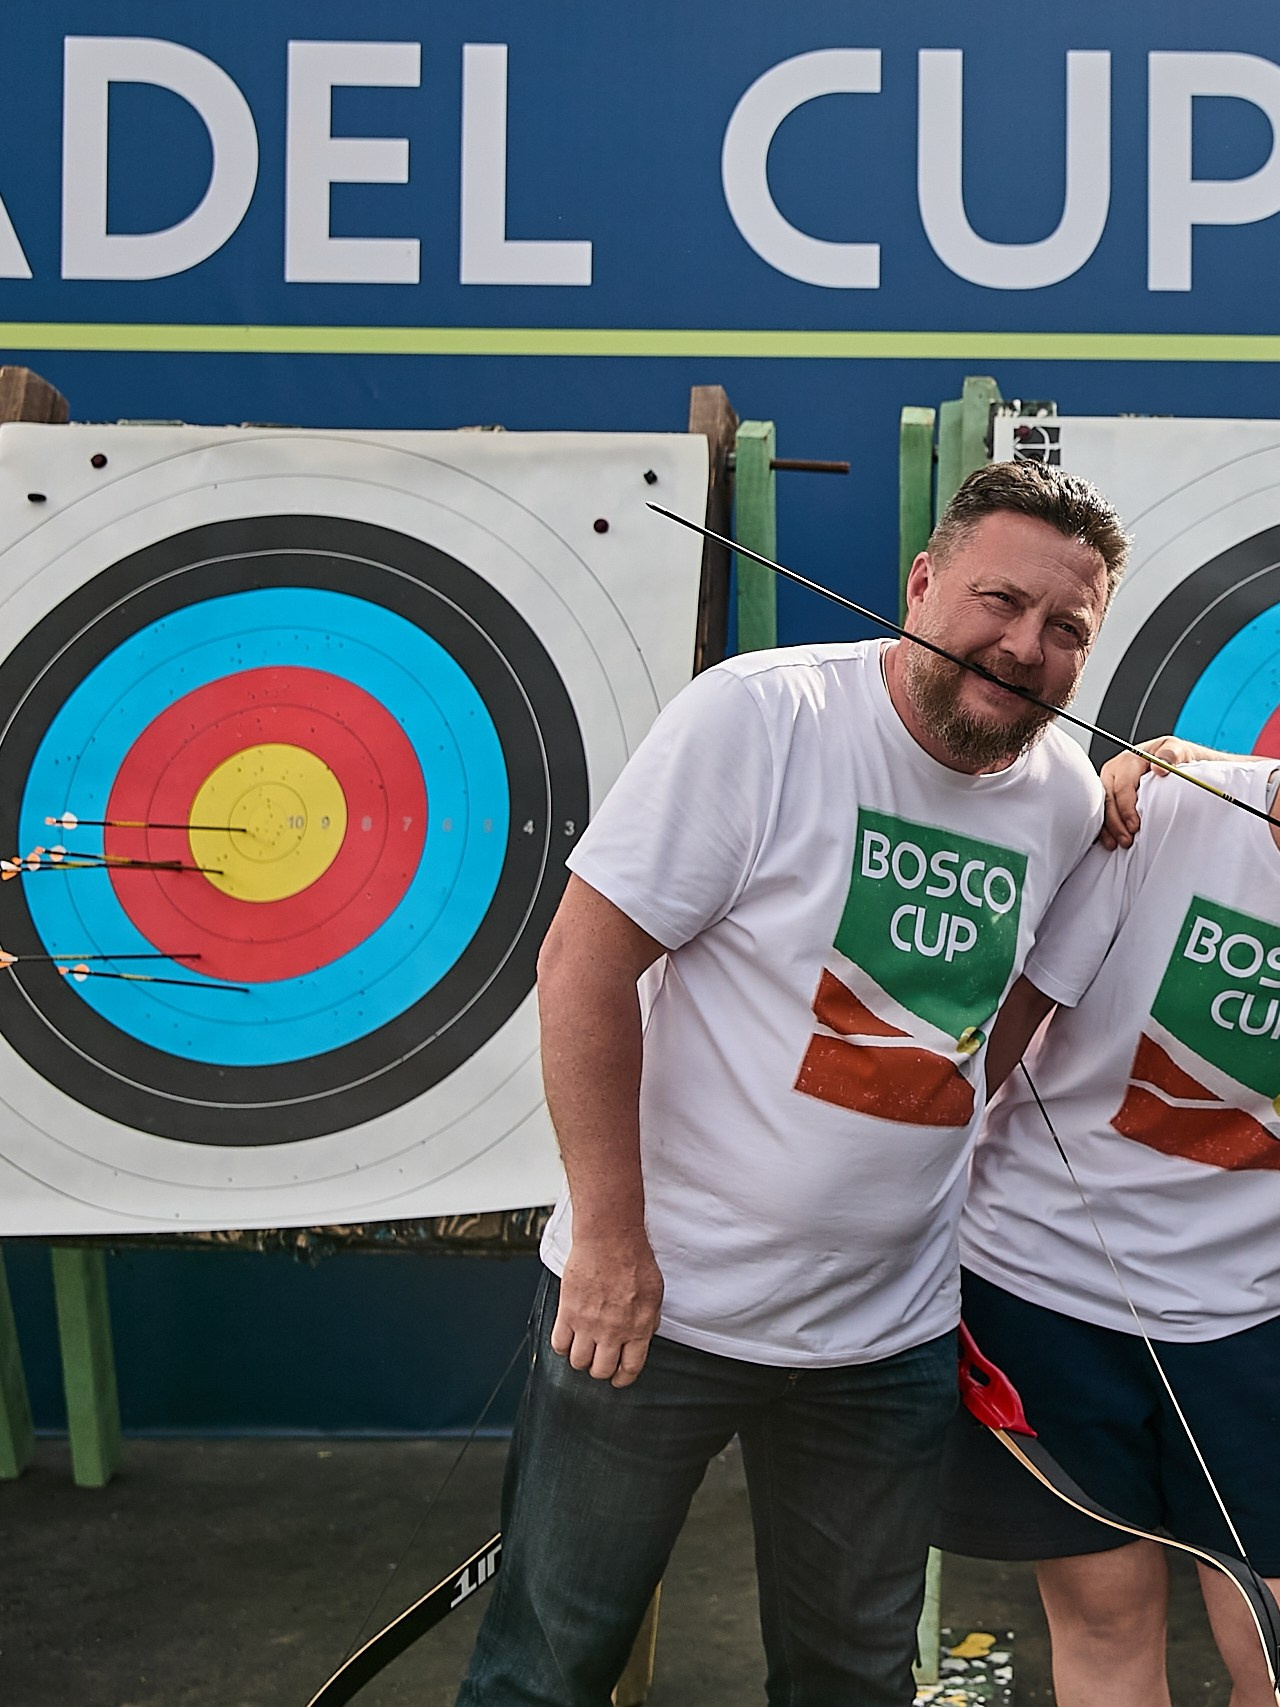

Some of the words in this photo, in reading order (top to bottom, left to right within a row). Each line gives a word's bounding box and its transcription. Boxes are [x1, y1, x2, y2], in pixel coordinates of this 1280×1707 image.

[0, 35, 593, 287] DEL
[288, 816, 304, 829] 10
[321, 816, 330, 830] 9
[402, 816, 413, 832] 7
[523, 819, 534, 835] 4
[564, 820, 575, 836] 3
[861, 829, 1017, 914] BOSCO
[890, 904, 978, 963] CUP
